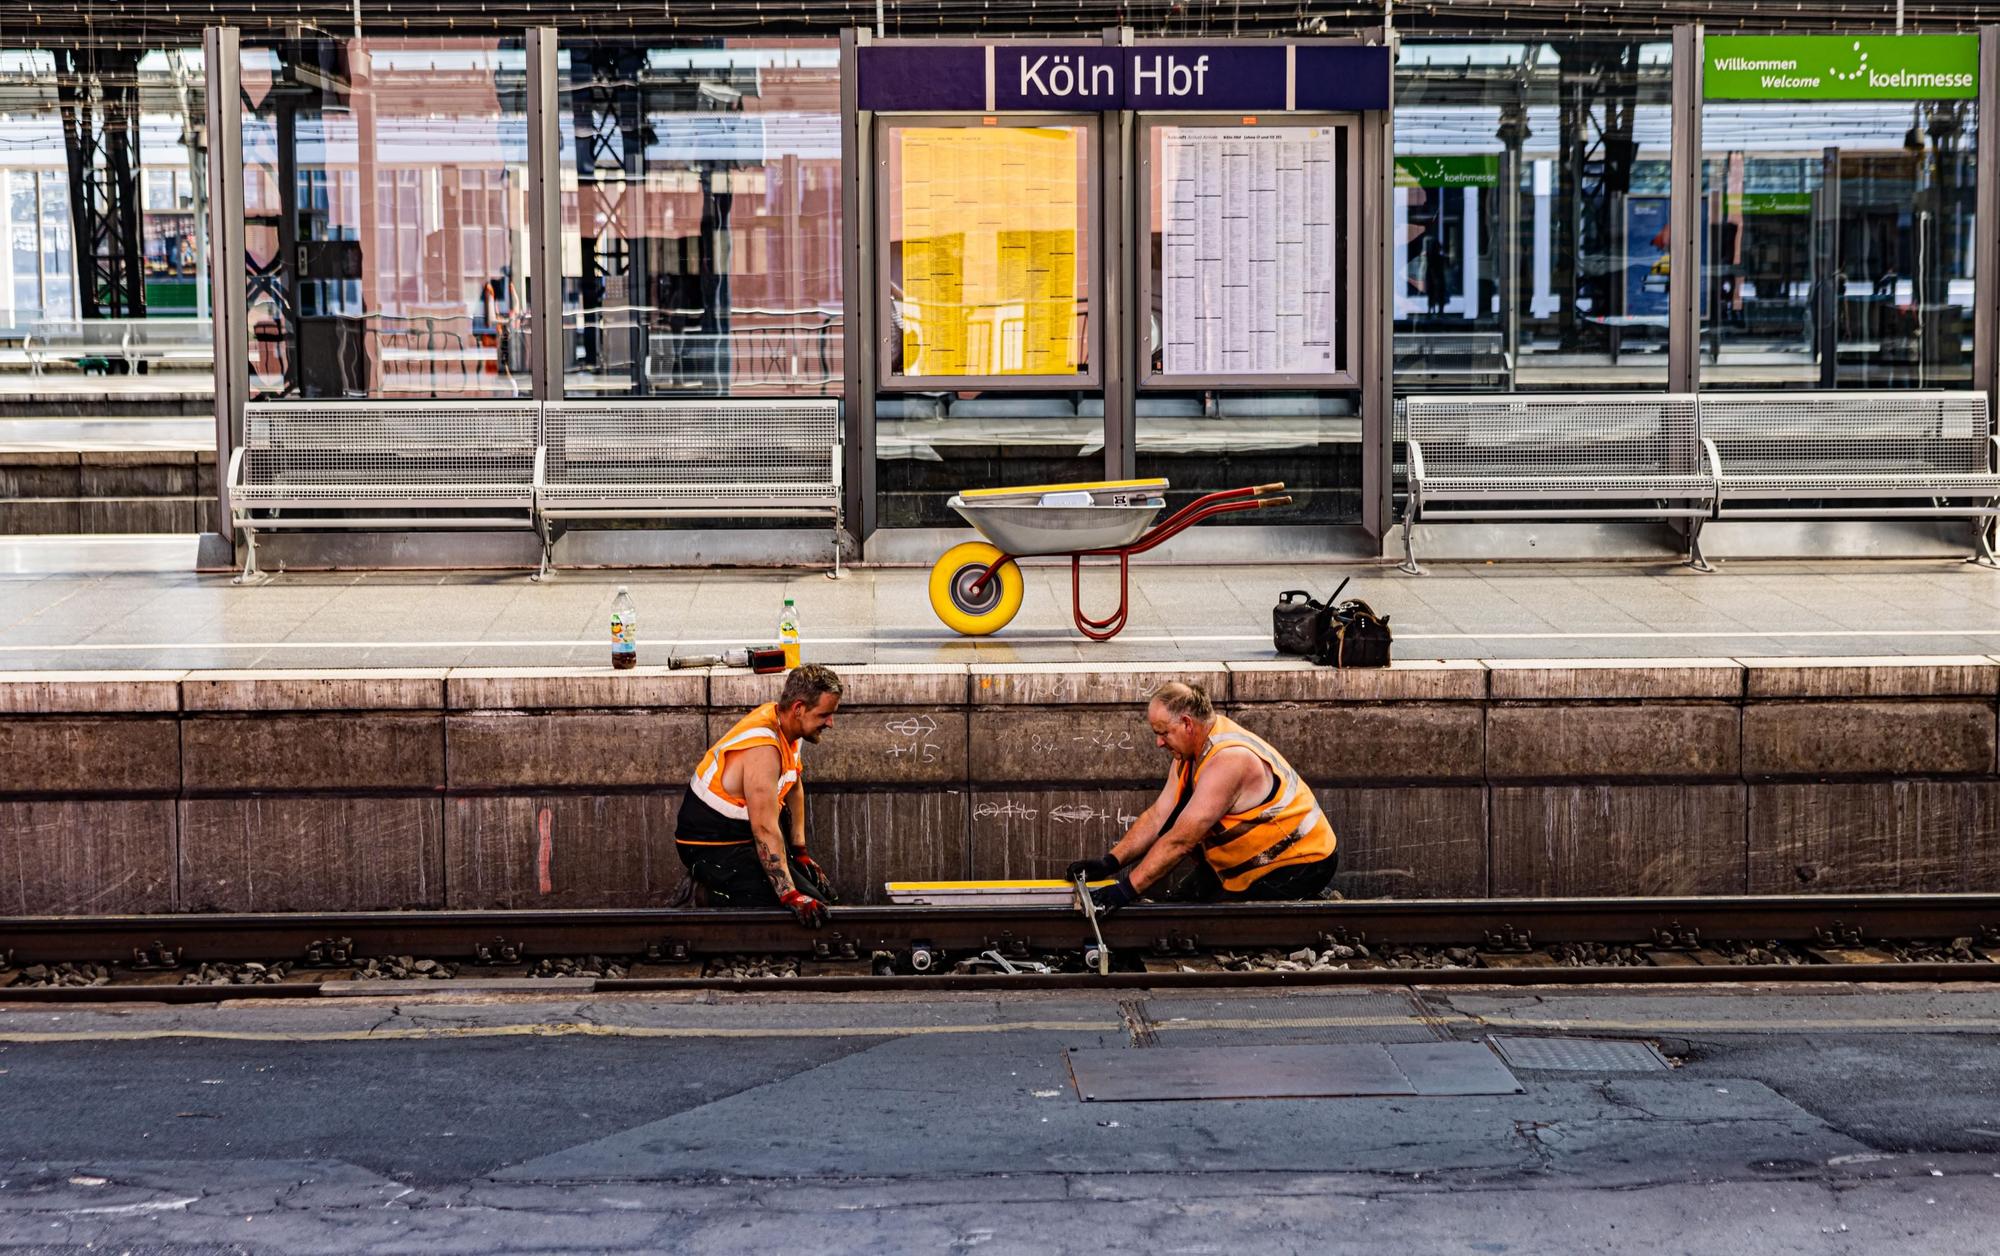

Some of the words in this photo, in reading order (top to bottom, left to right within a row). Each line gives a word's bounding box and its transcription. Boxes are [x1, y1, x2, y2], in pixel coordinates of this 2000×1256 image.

[1714, 58, 1797, 71] Willkommen
[1020, 55, 1114, 96] Köln
[1134, 55, 1209, 96] Hbf
[1761, 75, 1820, 88] Welcome
[1869, 68, 1973, 88] koelnmesse
[1444, 173, 1496, 183] koelnmesse
[886, 741, 941, 764] +15
